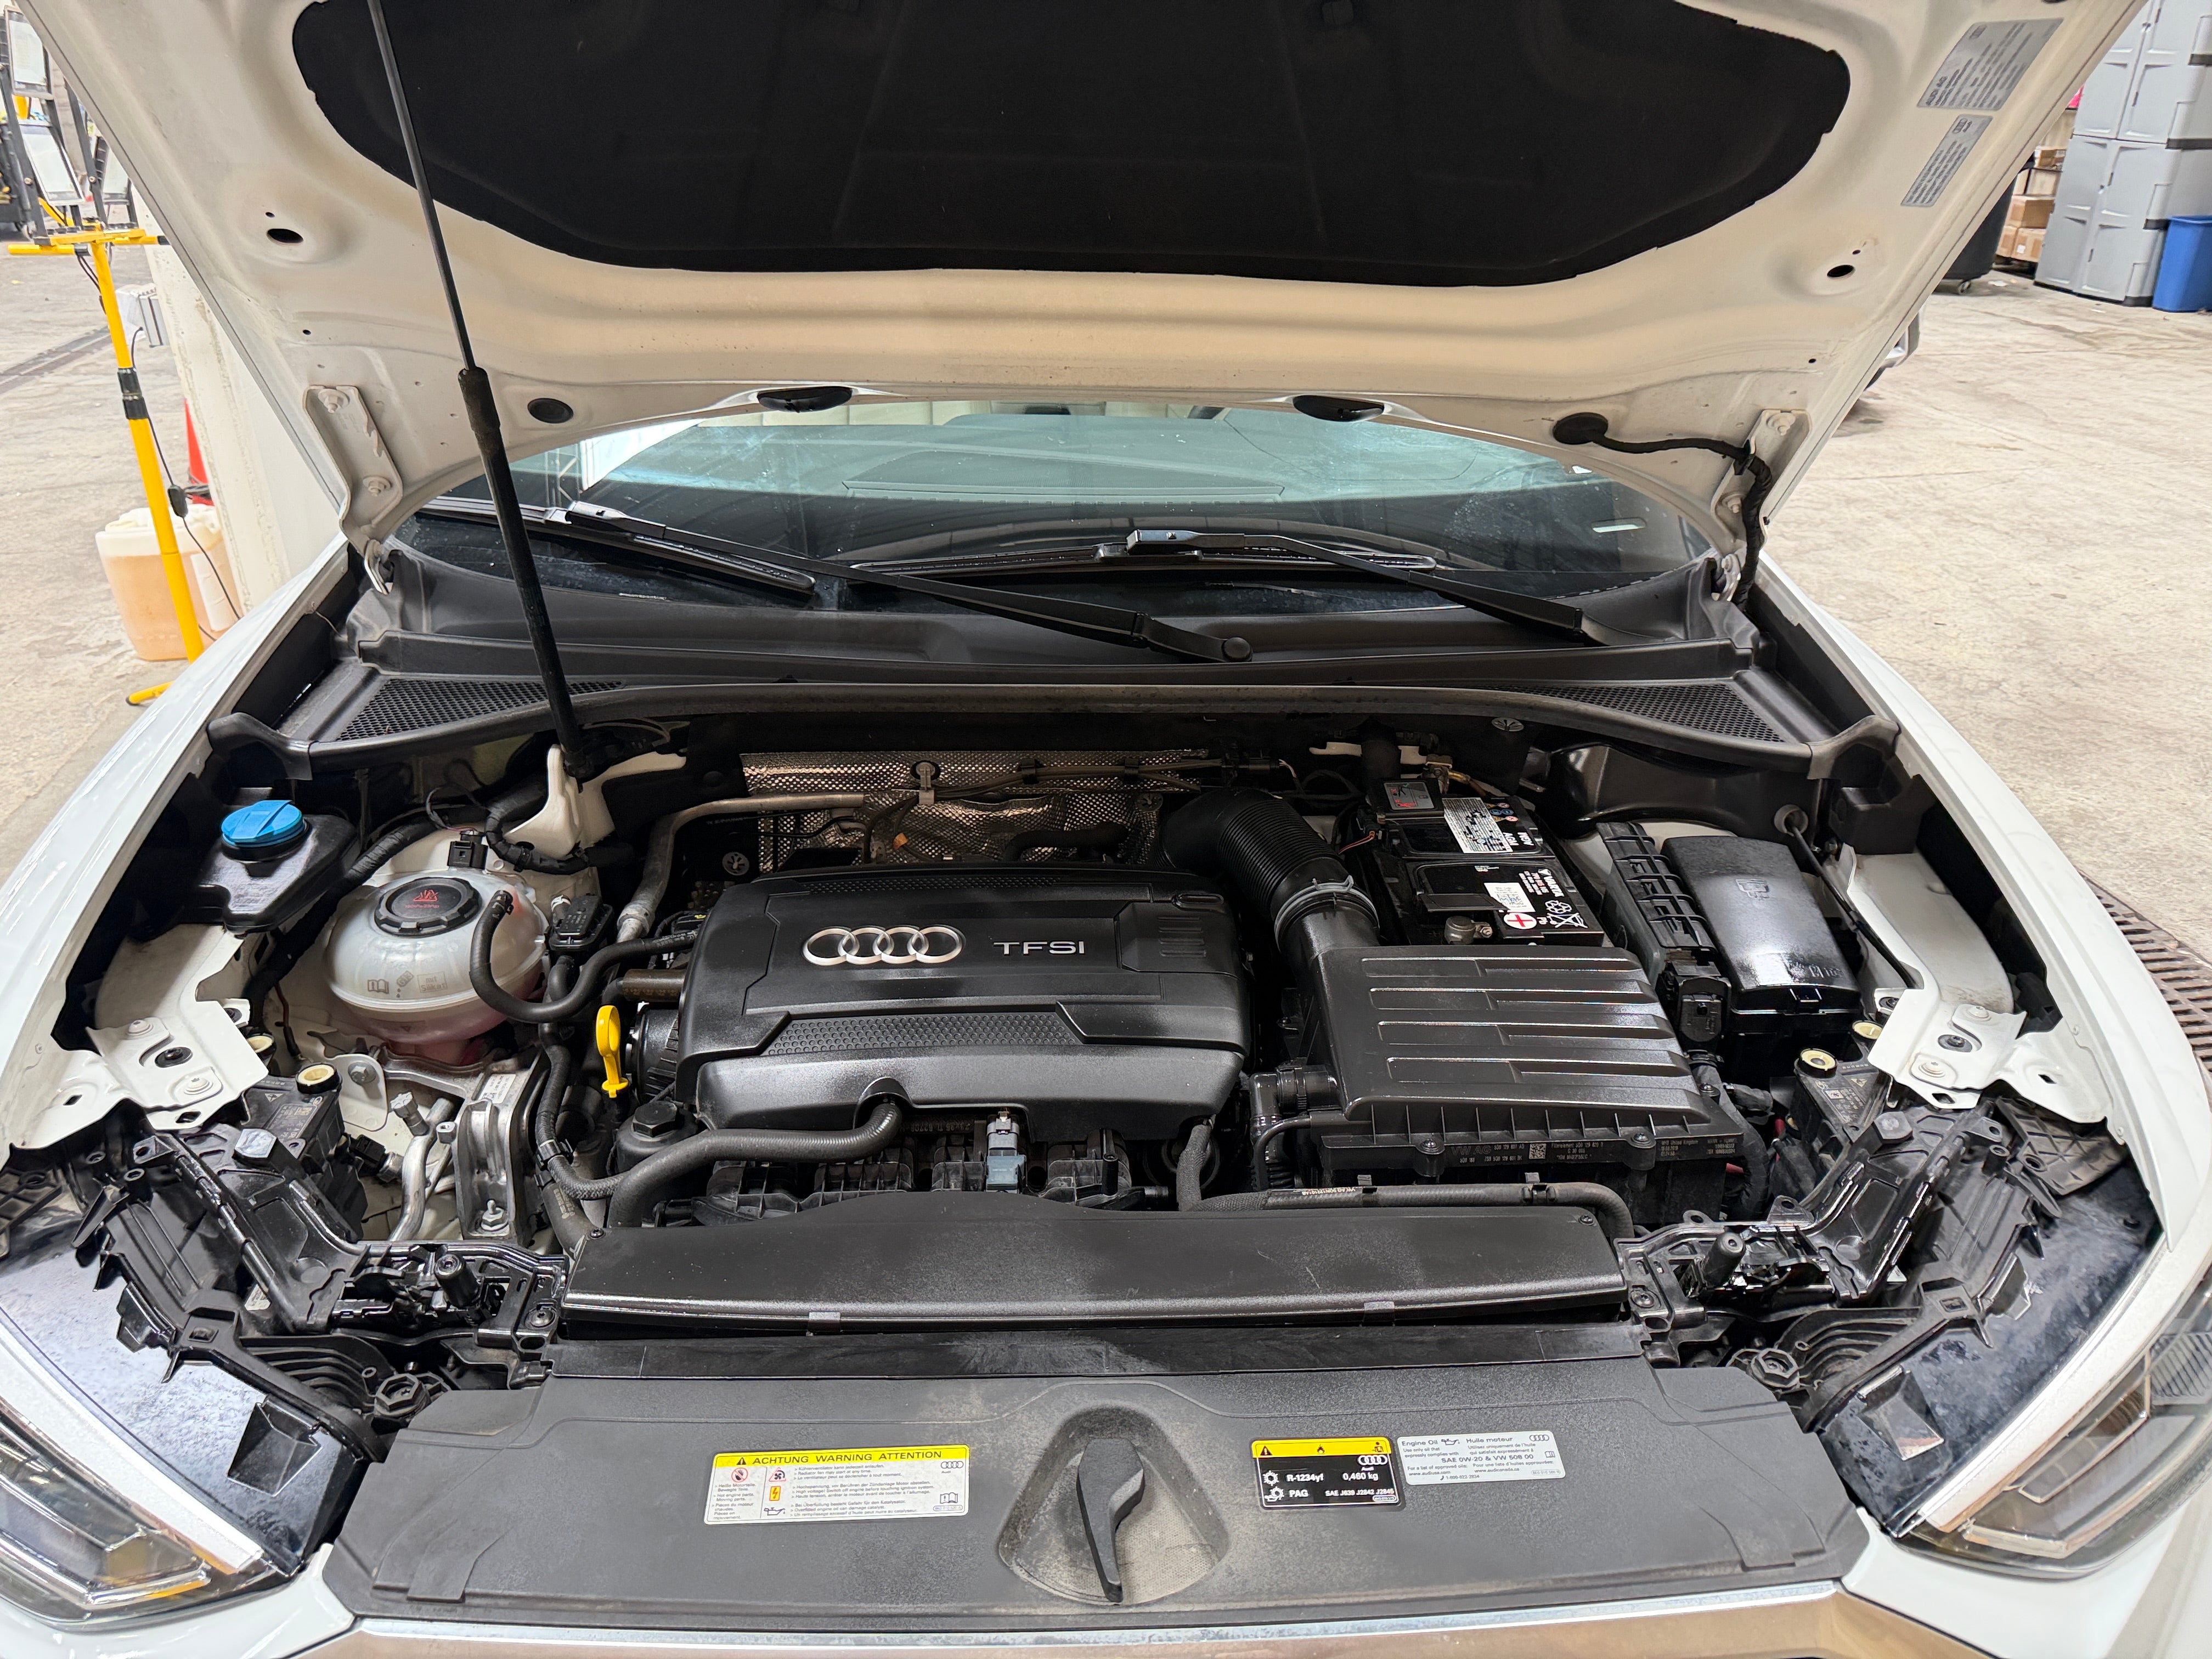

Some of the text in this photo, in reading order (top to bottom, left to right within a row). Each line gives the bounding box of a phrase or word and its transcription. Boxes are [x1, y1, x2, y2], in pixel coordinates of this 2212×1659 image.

[1503, 832, 1519, 845] AGM
[1517, 832, 1534, 845] AGM
[1544, 876, 1565, 897] VARTA
[994, 940, 1085, 955] TFSI
[421, 983, 447, 991] Silikat
[1451, 1145, 1492, 1155] VW AG
[752, 1456, 809, 1464] ACHTUNG
[879, 1451, 941, 1459] ATTENTION
[1286, 1472, 1379, 1482] R-1234yf 0,460 kg
[1289, 1489, 1309, 1498] PAG
